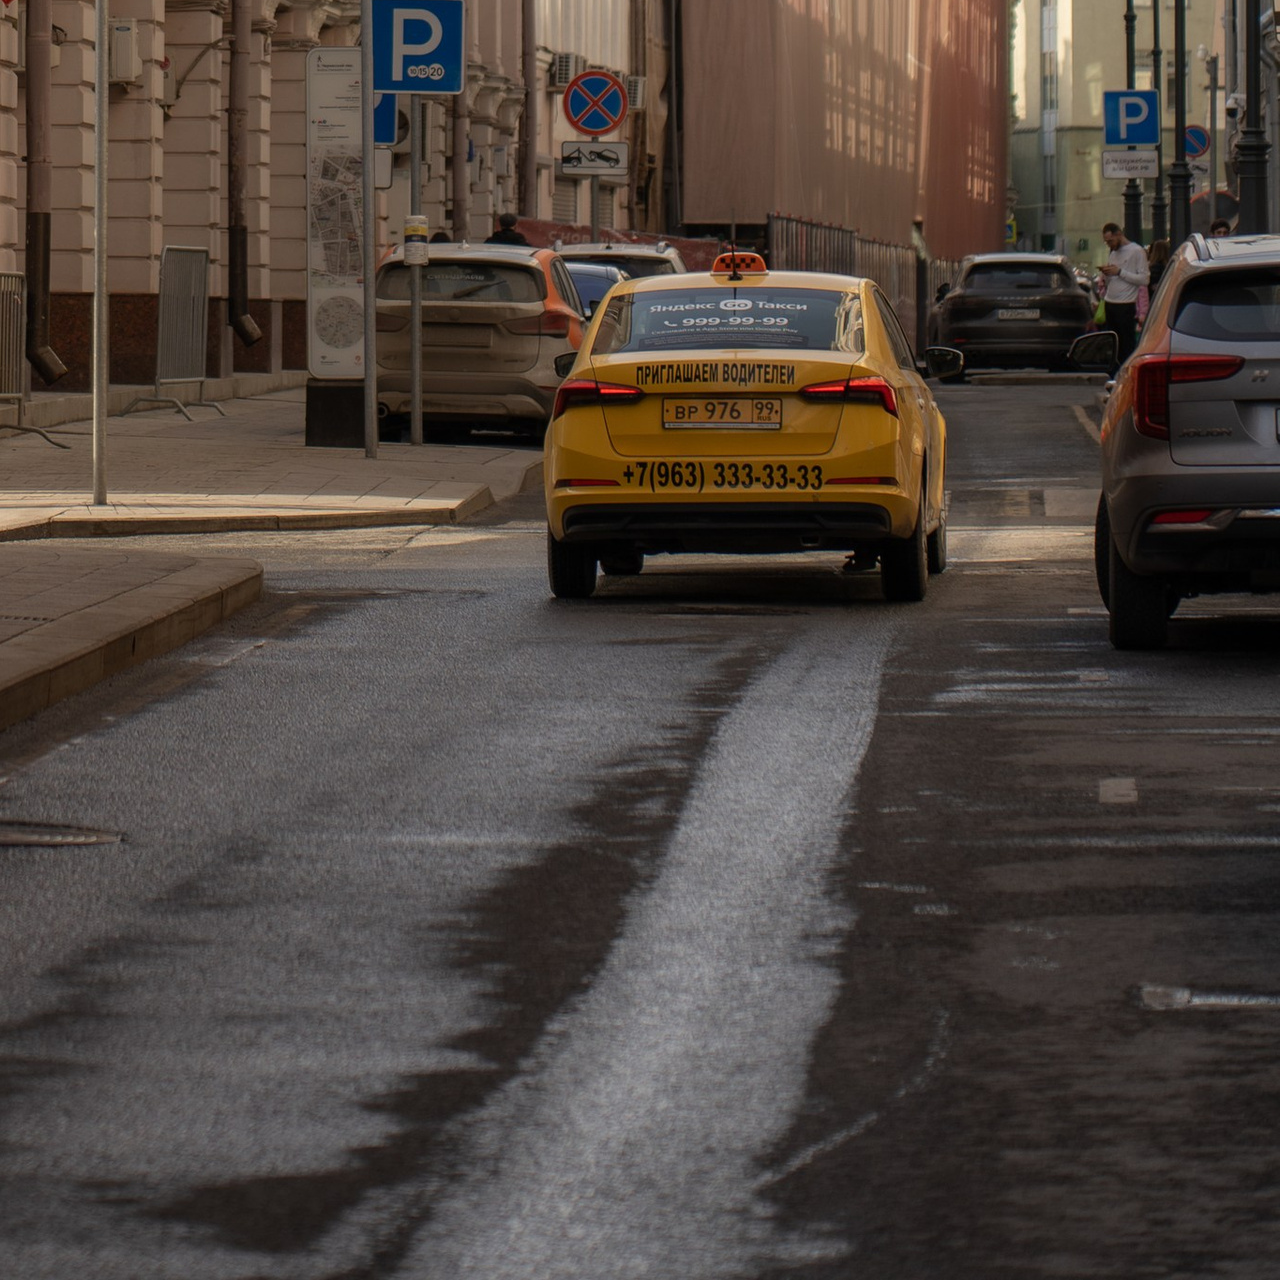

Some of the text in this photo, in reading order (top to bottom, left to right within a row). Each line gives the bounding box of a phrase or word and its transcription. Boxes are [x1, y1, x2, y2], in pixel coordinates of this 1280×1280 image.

[392, 8, 443, 81] P
[419, 67, 427, 75] 15
[430, 67, 443, 77] 20
[1119, 97, 1149, 139] P
[650, 302, 716, 313] Яндекс
[756, 301, 807, 311] Такси
[682, 317, 789, 327] 999-99-99
[636, 363, 719, 385] ПРИГЛАШАЕМ
[705, 402, 741, 420] 976
[754, 401, 774, 415] 99
[623, 461, 823, 493] +7(963) 333-33-33
